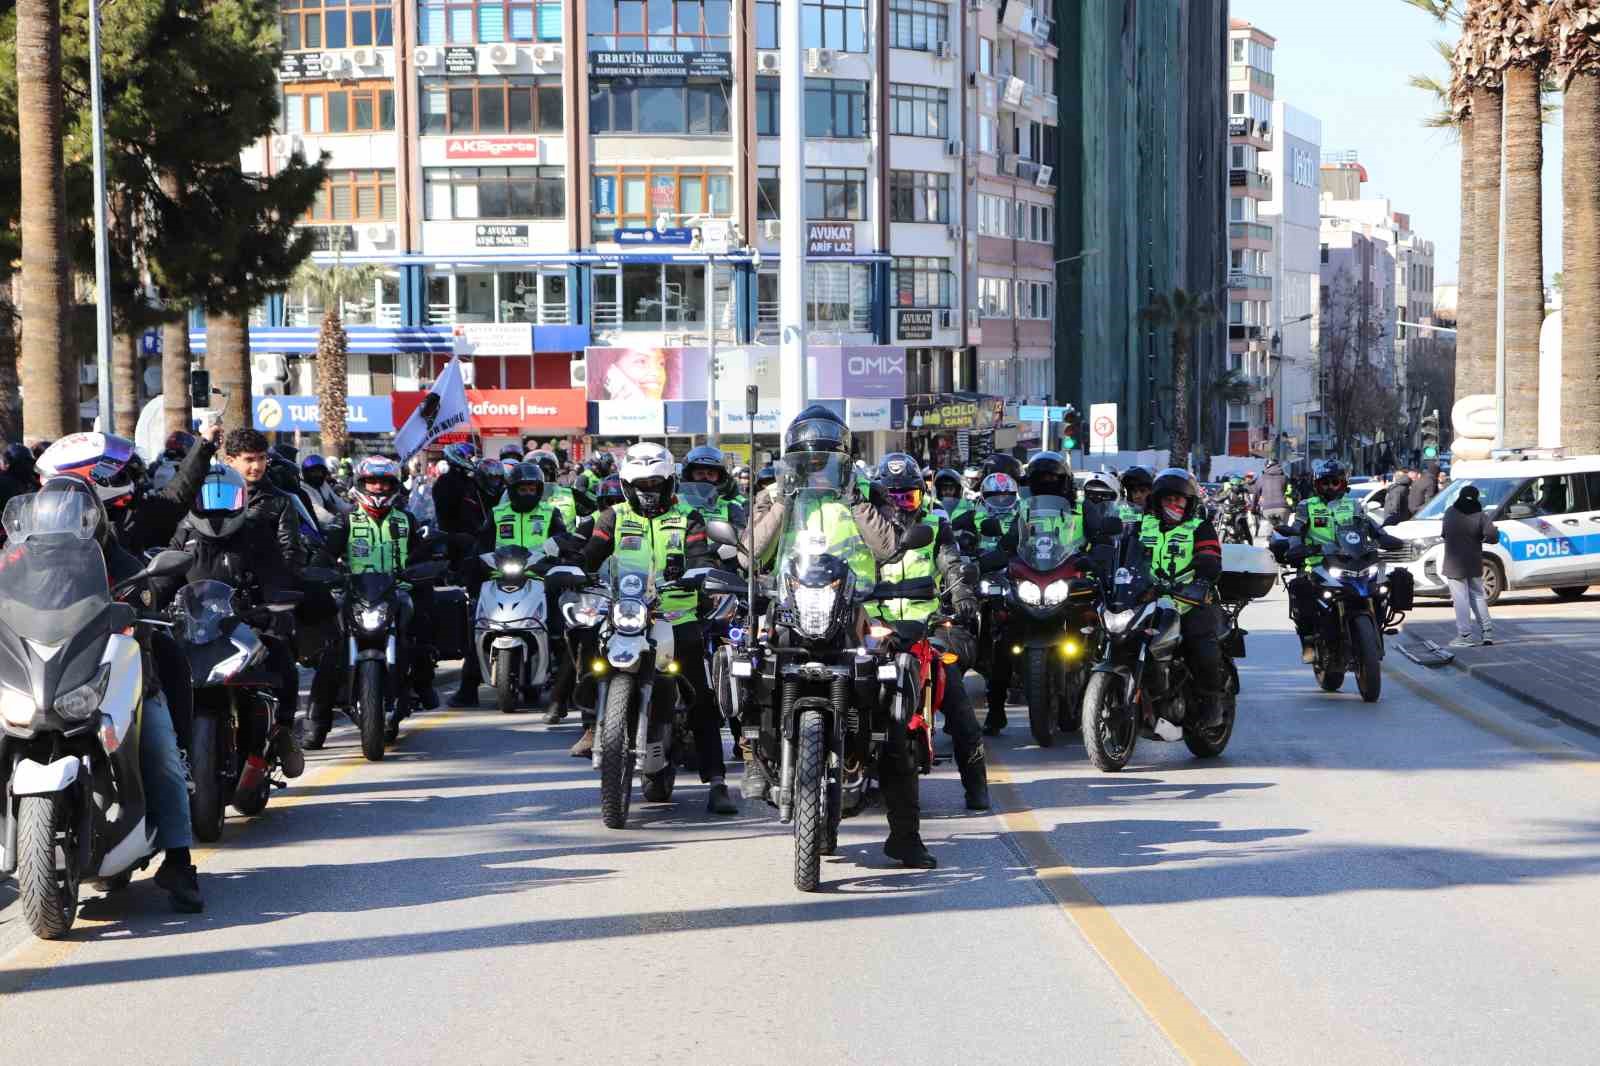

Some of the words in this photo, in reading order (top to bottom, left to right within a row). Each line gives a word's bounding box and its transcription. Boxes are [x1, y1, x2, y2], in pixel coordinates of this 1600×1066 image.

[598, 51, 645, 64] ERBEYİN
[646, 53, 684, 64] HUKUK
[487, 226, 518, 236] AVUKAT
[810, 226, 852, 240] AVUKAT
[810, 240, 833, 252] ARİF
[834, 242, 853, 252] LAZ
[902, 313, 932, 323] AVUKAT
[847, 356, 904, 376] OMIX
[287, 405, 369, 423] TURLL
[941, 403, 976, 417] GOLD
[745, 413, 777, 422] Tlekom
[1525, 538, 1570, 558] POLİS
